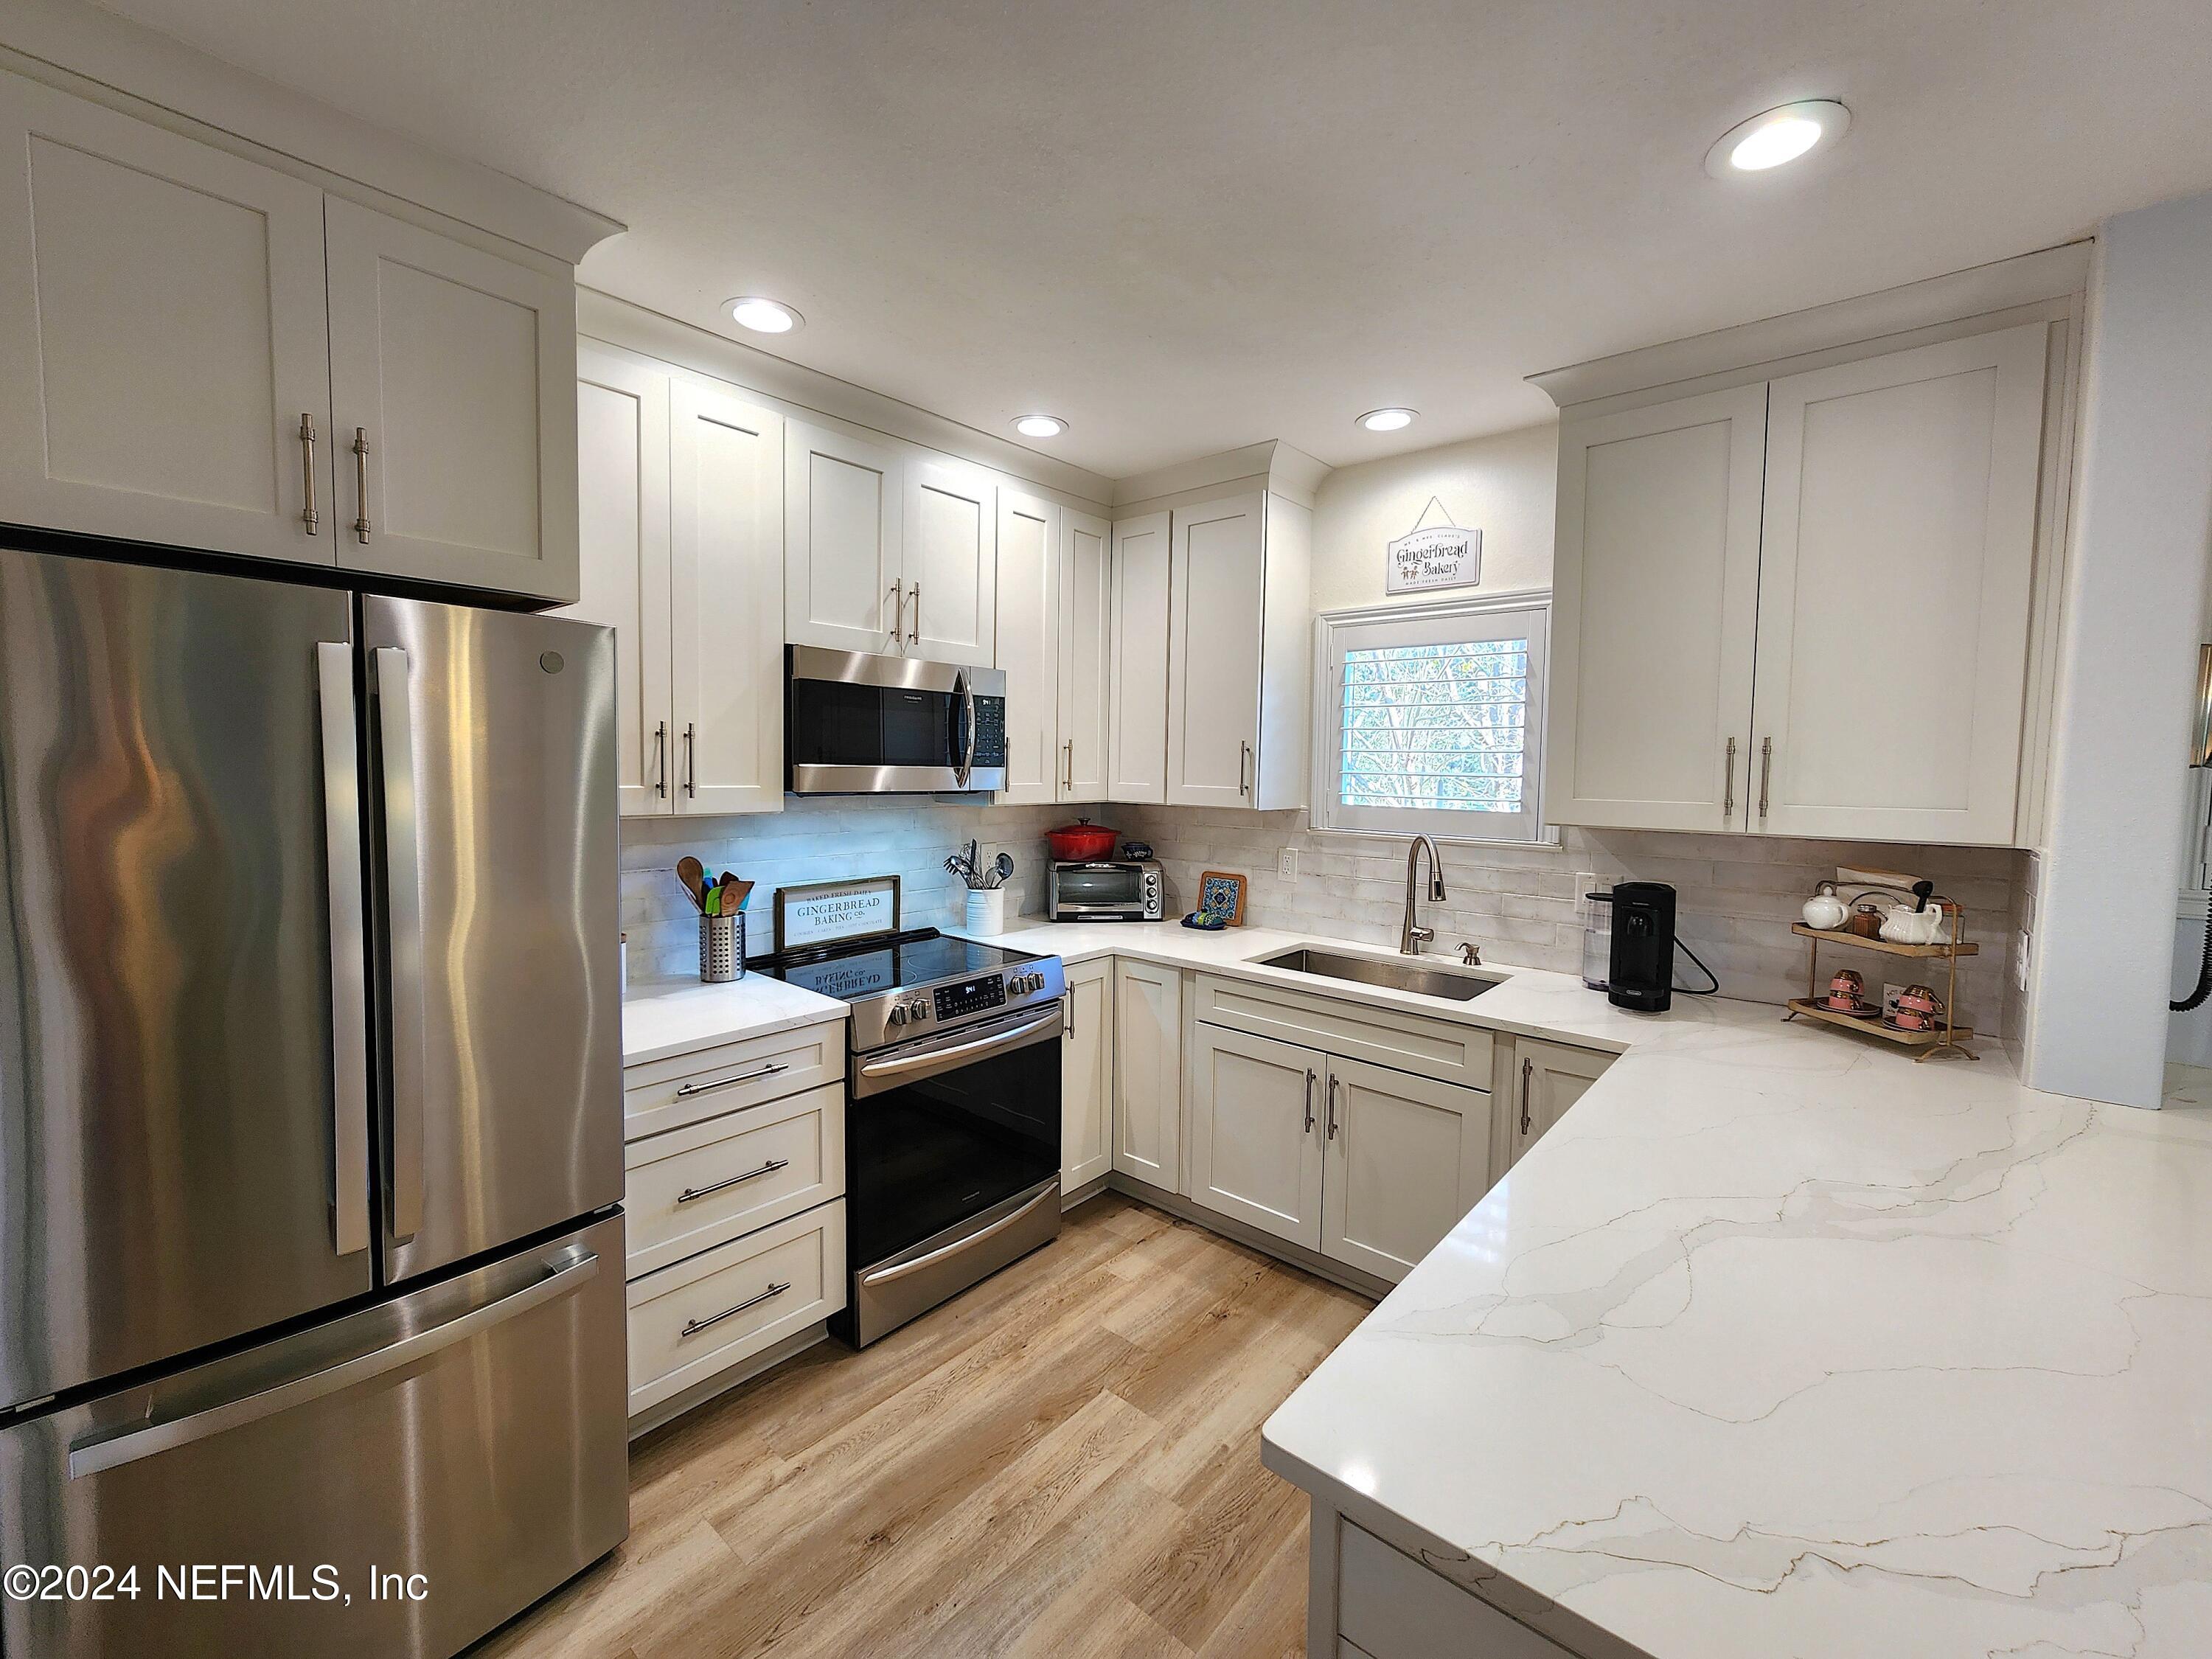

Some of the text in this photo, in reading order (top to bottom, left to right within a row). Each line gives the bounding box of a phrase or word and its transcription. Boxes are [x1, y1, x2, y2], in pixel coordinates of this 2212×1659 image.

[1397, 540, 1468, 568] Gingerbread
[1422, 560, 1461, 576] Bakery
[807, 894, 829, 903] BAKED
[797, 897, 880, 917] GINGERBREAD
[815, 912, 852, 925] BAKING
